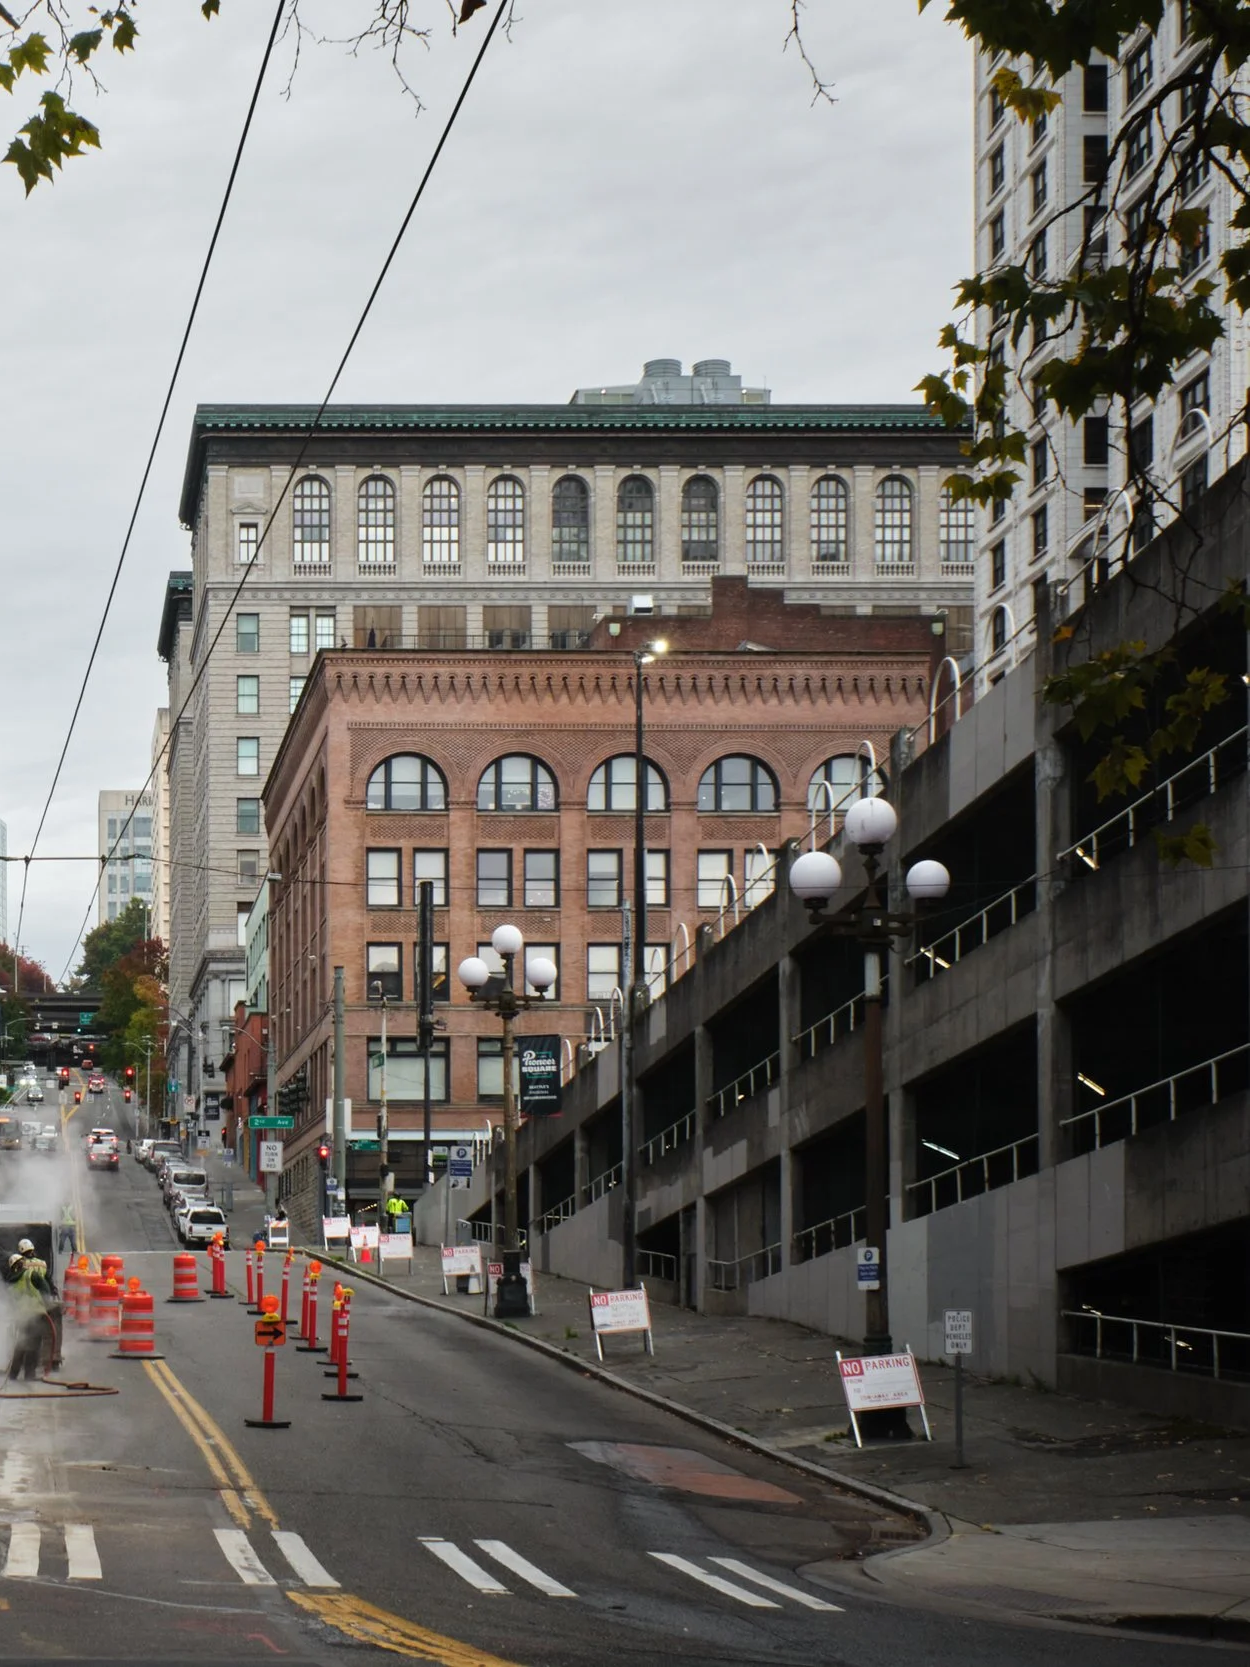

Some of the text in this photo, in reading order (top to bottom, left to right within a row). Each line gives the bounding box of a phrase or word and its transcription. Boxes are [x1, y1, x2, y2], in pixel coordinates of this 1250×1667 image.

[521, 1065, 557, 1073] SQUARE
[443, 1249, 453, 1257] NO
[593, 1292, 643, 1306] NO PARKING
[947, 1315, 970, 1323] POLICE
[842, 1357, 910, 1375] NO PARKING
